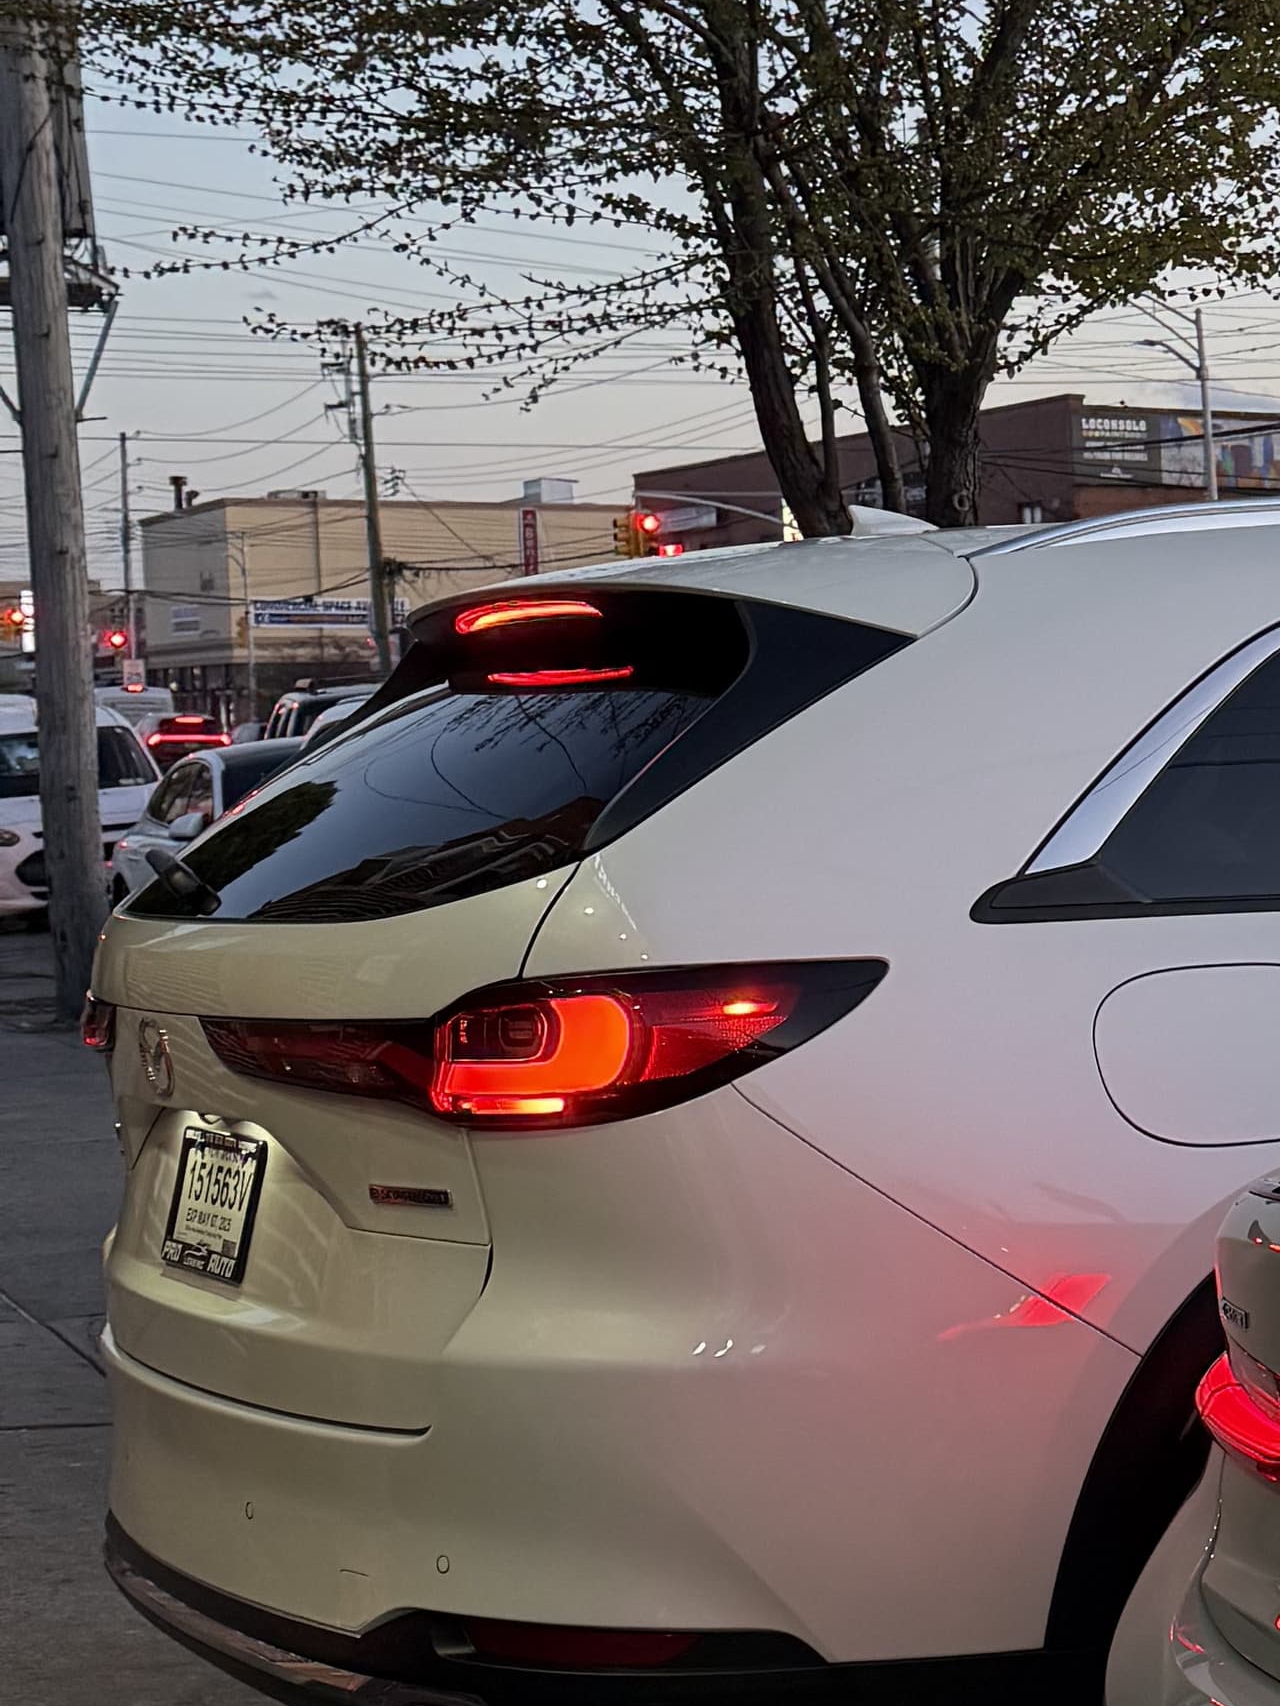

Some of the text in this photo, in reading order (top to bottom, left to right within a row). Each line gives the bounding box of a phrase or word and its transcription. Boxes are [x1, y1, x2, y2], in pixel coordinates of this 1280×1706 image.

[1081, 417, 1147, 432] LOCONSOLO
[188, 1160, 254, 1212] 151563V
[162, 1242, 182, 1263] PRO
[207, 1254, 236, 1278] AUTO
